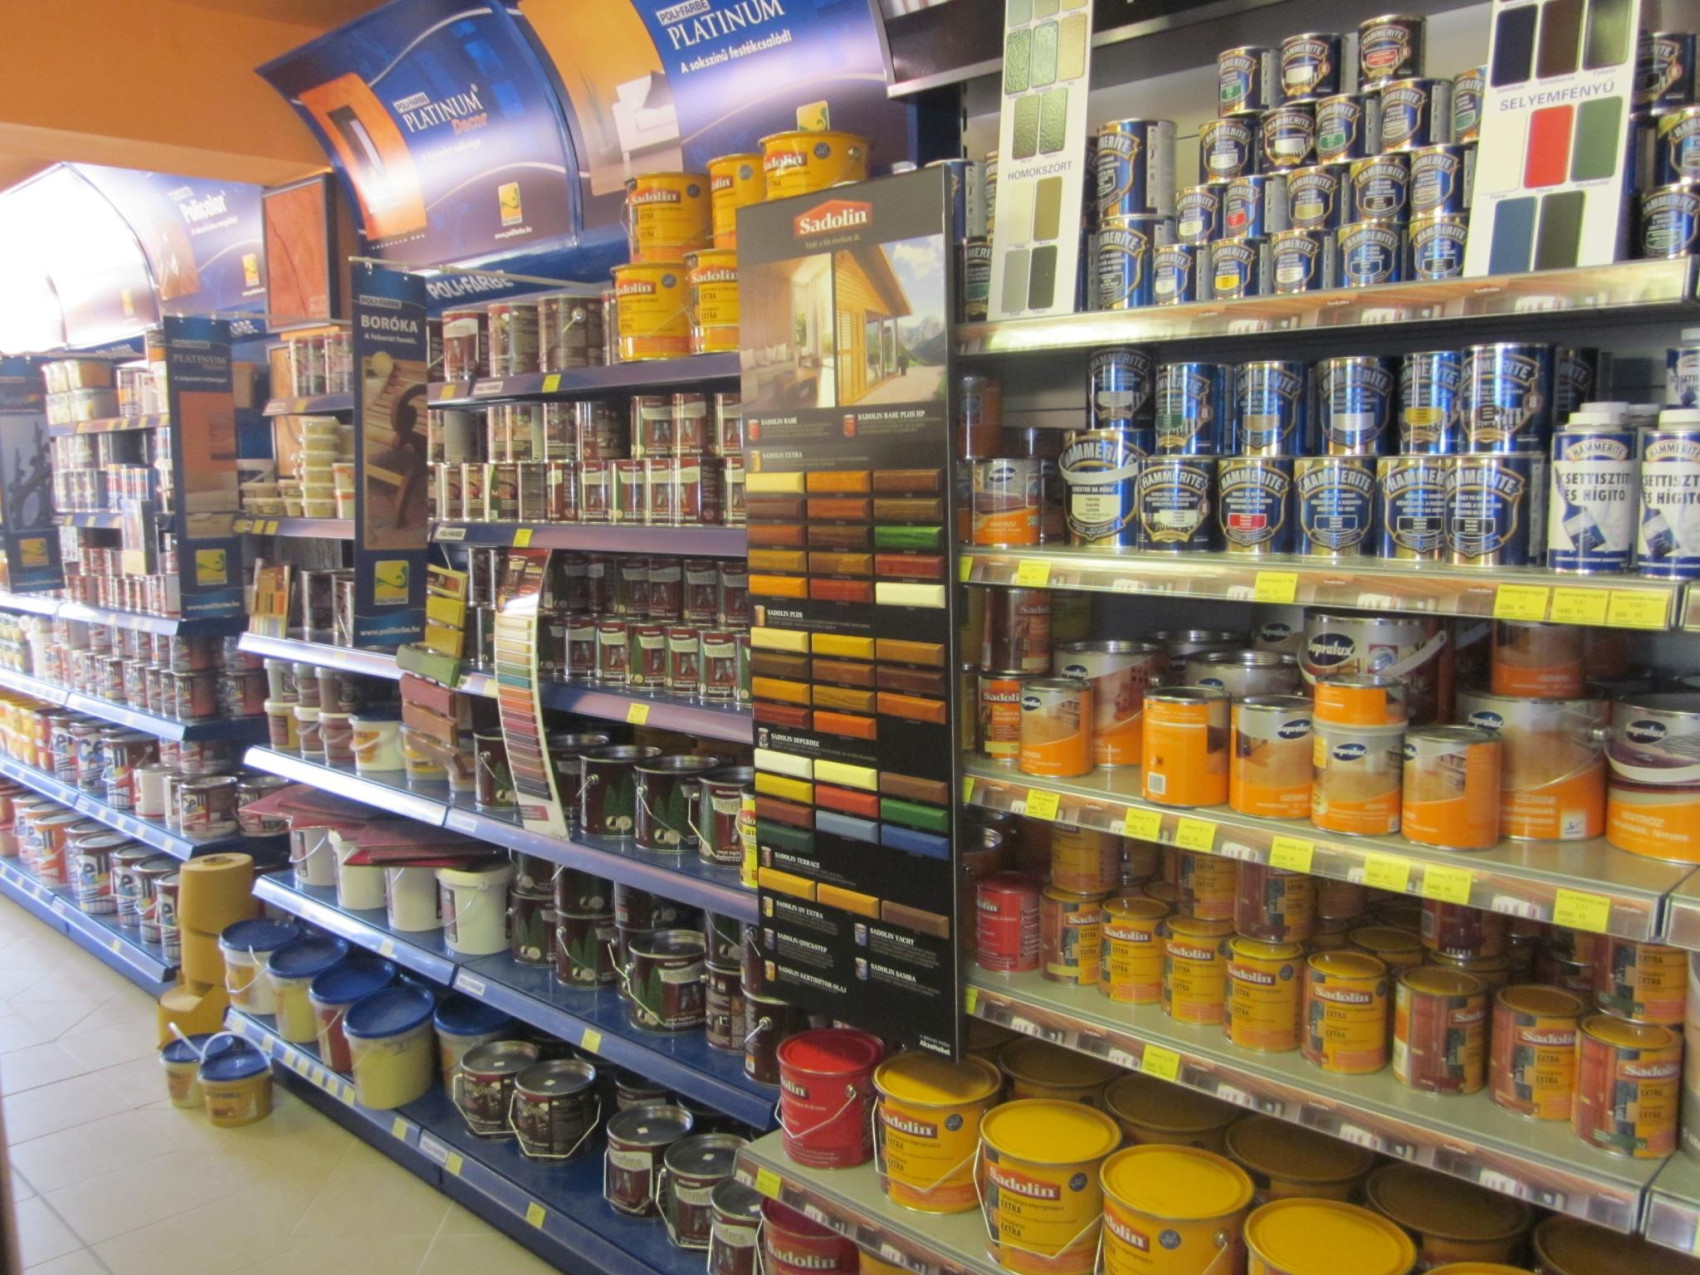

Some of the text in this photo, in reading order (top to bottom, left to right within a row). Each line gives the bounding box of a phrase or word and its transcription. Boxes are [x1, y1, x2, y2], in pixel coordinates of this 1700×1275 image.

[667, 0, 786, 50] PLATINUM
[1362, 27, 1405, 46] HAMMERITE
[681, 62, 690, 74] A
[729, 29, 792, 58] festékcsalád!
[402, 92, 484, 132] PLATINUM
[1267, 113, 1312, 131] HAMMERITE
[764, 154, 803, 173] adolin
[1358, 163, 1406, 184] HAMMERITE
[800, 207, 866, 235] Sadolin
[1416, 224, 1467, 243] HAMMERITE
[427, 274, 514, 299] POLI-FARBE
[616, 282, 652, 297] adolin
[361, 313, 418, 333] BORÓKA
[1142, 472, 1204, 490] HAMMERITE
[1221, 466, 1284, 490] HAMMERITE
[1303, 467, 1372, 493] HAMMERITE
[1388, 467, 1444, 494] HAMMER
[1308, 640, 1355, 659] Supralux
[983, 691, 1020, 703] Sadoli
[1069, 914, 1099, 925] Sado
[1104, 926, 1149, 942] Sadolin
[1314, 986, 1370, 1004] Sadolin
[1522, 1031, 1576, 1045] Sadoli
[1537, 1053, 1561, 1063] EXTRA
[1536, 1075, 1559, 1085] EXTRA
[1625, 1065, 1679, 1078] Sadoli
[989, 1165, 1056, 1199] Sadolin
[1001, 1199, 1022, 1215] EXTRA
[1001, 1222, 1022, 1238] EXTRA
[1104, 1211, 1146, 1249] dolin
